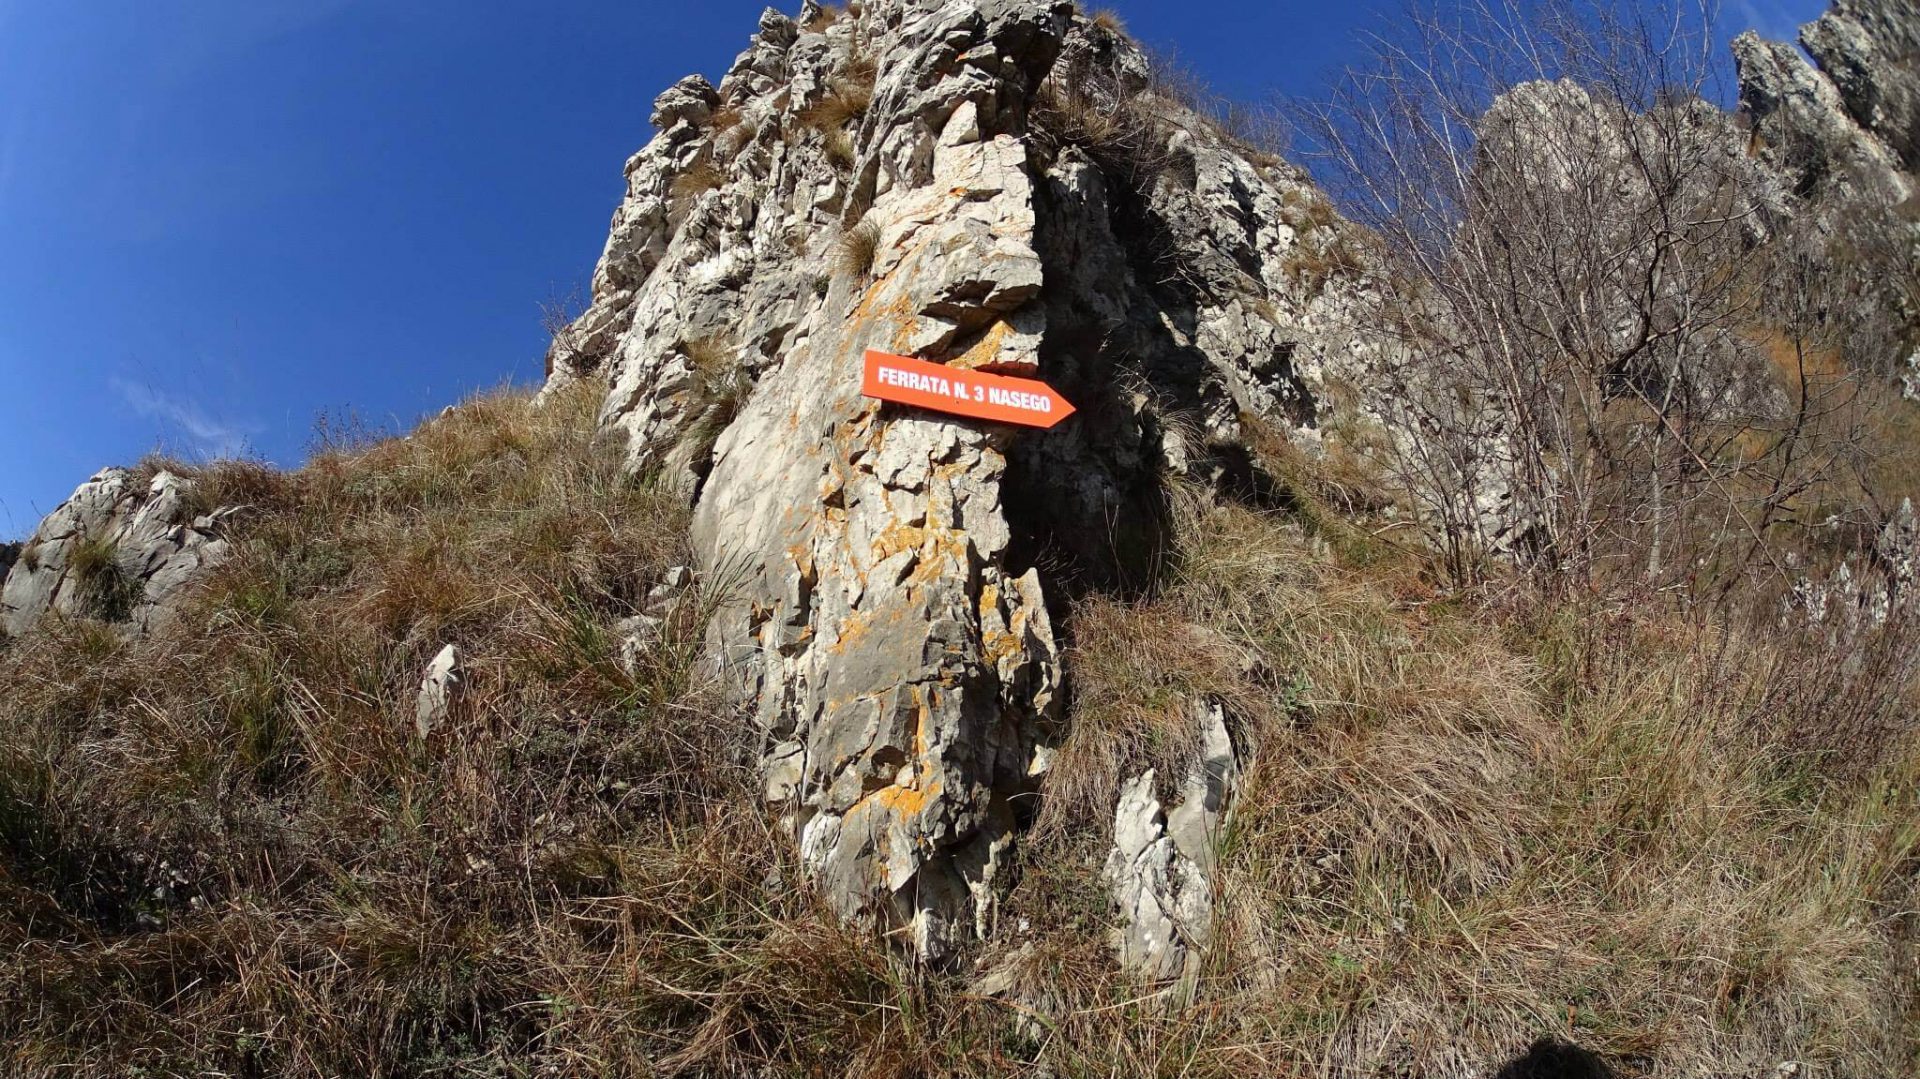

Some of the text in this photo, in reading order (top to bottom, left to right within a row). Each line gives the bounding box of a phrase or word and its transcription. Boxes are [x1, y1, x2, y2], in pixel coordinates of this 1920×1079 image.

[878, 366, 1051, 413] FERRATA N. 3 NASEGO
